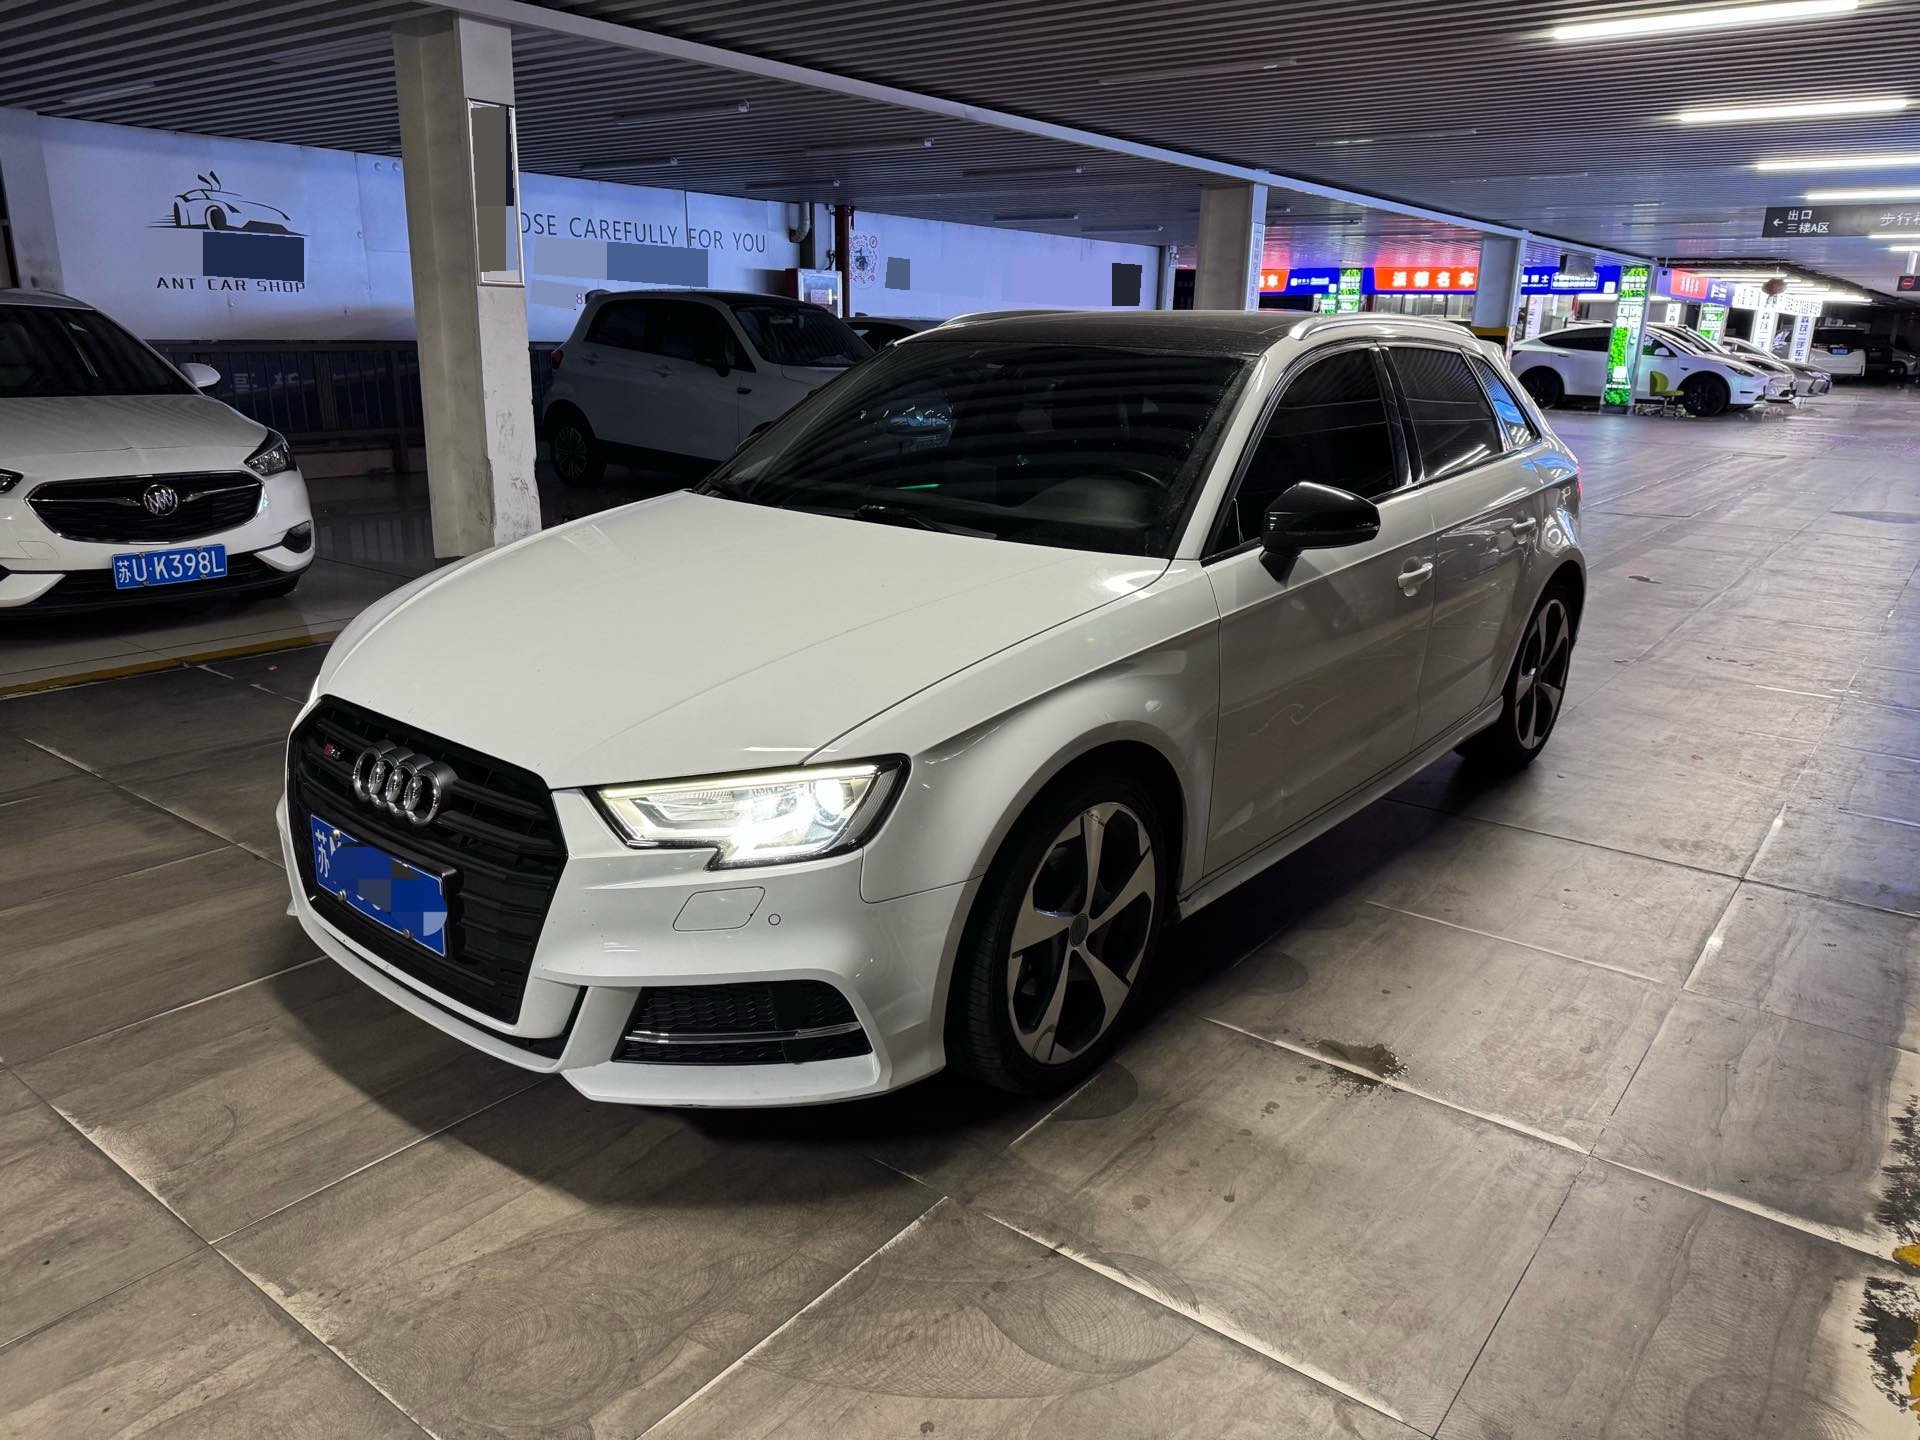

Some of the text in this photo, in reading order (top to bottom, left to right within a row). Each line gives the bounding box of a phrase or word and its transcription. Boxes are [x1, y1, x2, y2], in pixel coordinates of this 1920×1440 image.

[1788, 209, 1813, 221] 出口
[1785, 222, 1830, 234] 三楼A区
[569, 217, 678, 245] CAREFULLY
[688, 228, 724, 250] FOR
[733, 231, 766, 254] YOU
[156, 276, 306, 293] ANT CAR SHOP
